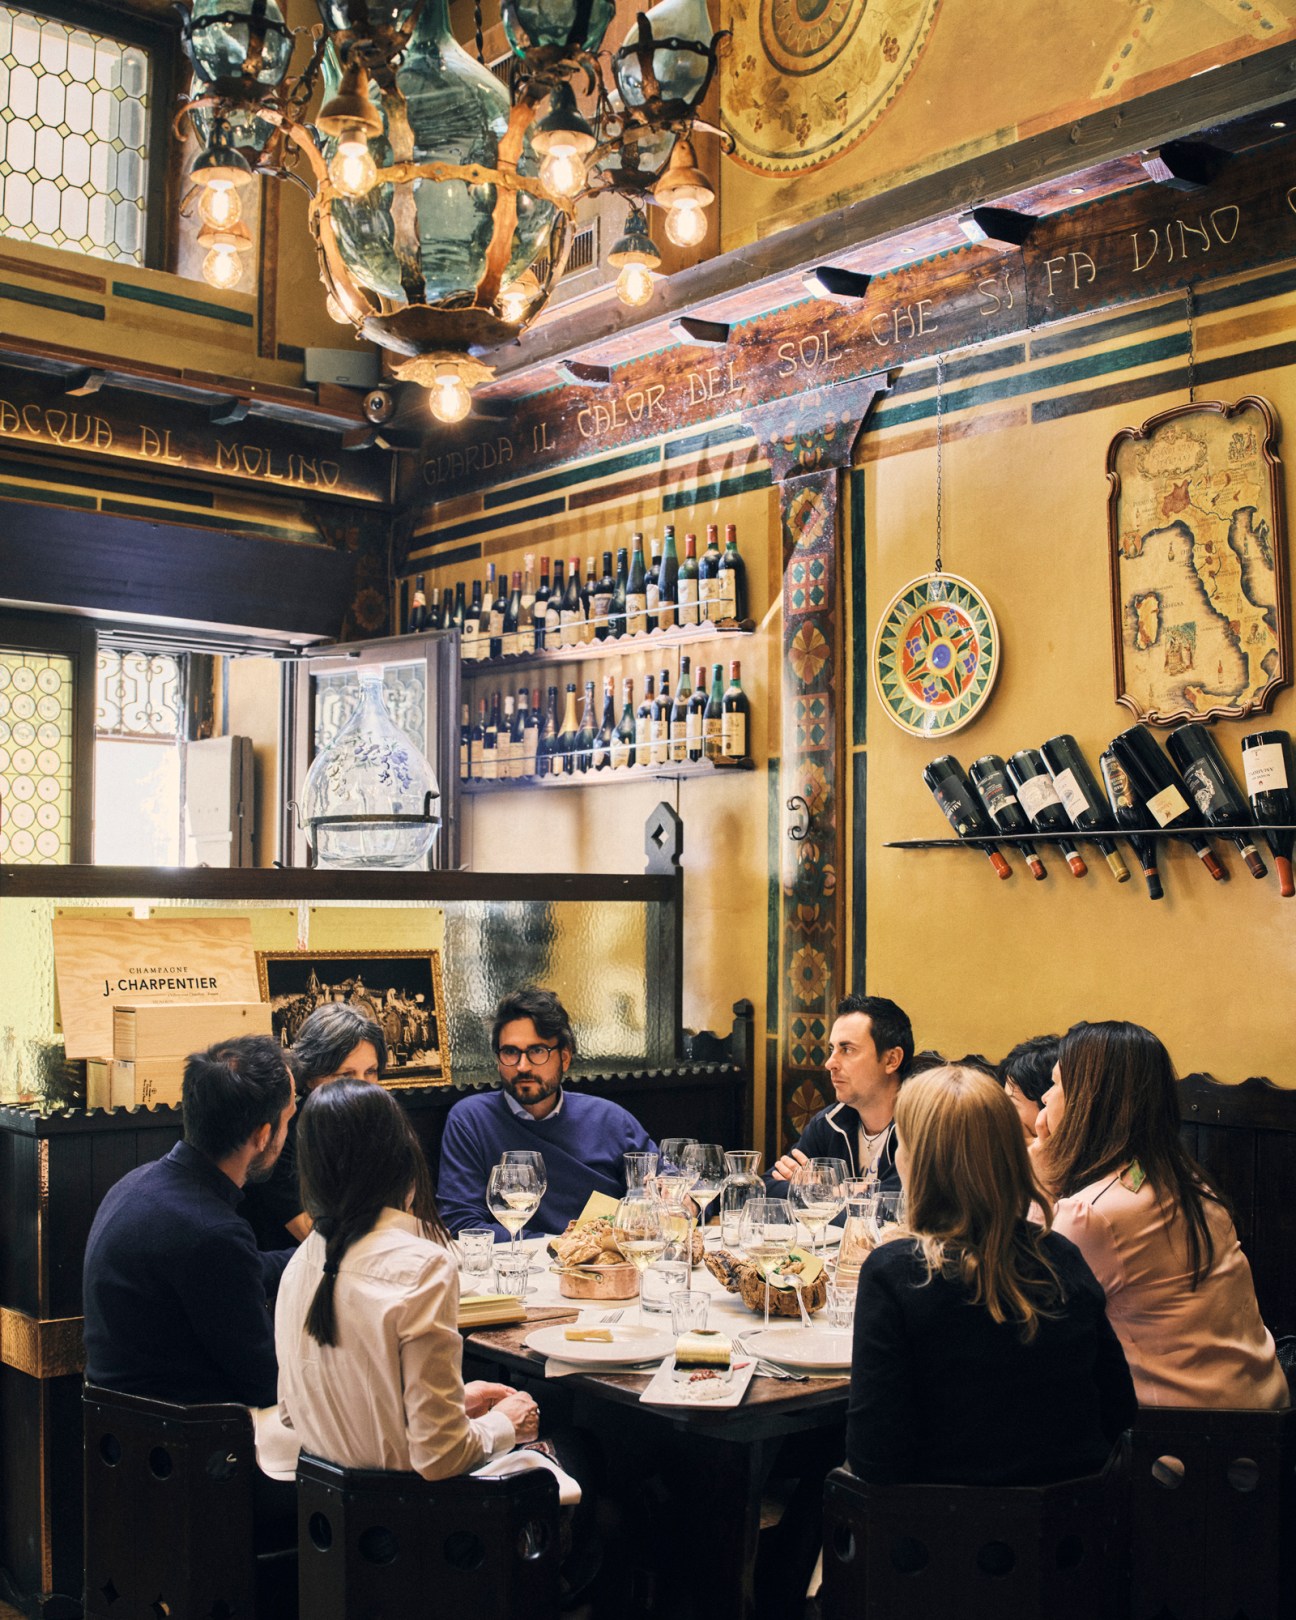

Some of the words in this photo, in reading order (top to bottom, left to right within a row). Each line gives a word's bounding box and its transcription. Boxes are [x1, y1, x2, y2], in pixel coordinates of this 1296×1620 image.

[422, 437, 513, 486] GUARDA
[533, 422, 556, 453] IL
[576, 384, 667, 438] CALOR
[687, 361, 747, 406] DEL
[777, 329, 842, 379] SOL
[870, 298, 938, 347] CHE
[1043, 250, 1096, 297] FA
[1131, 204, 1240, 272] VINO
[138, 425, 182, 461] AL
[215, 440, 340, 488] MOLINO
[103, 979, 115, 998] J.
[118, 977, 218, 991] CHARPENTIER
[129, 966, 189, 975] CHAMPAGNE
